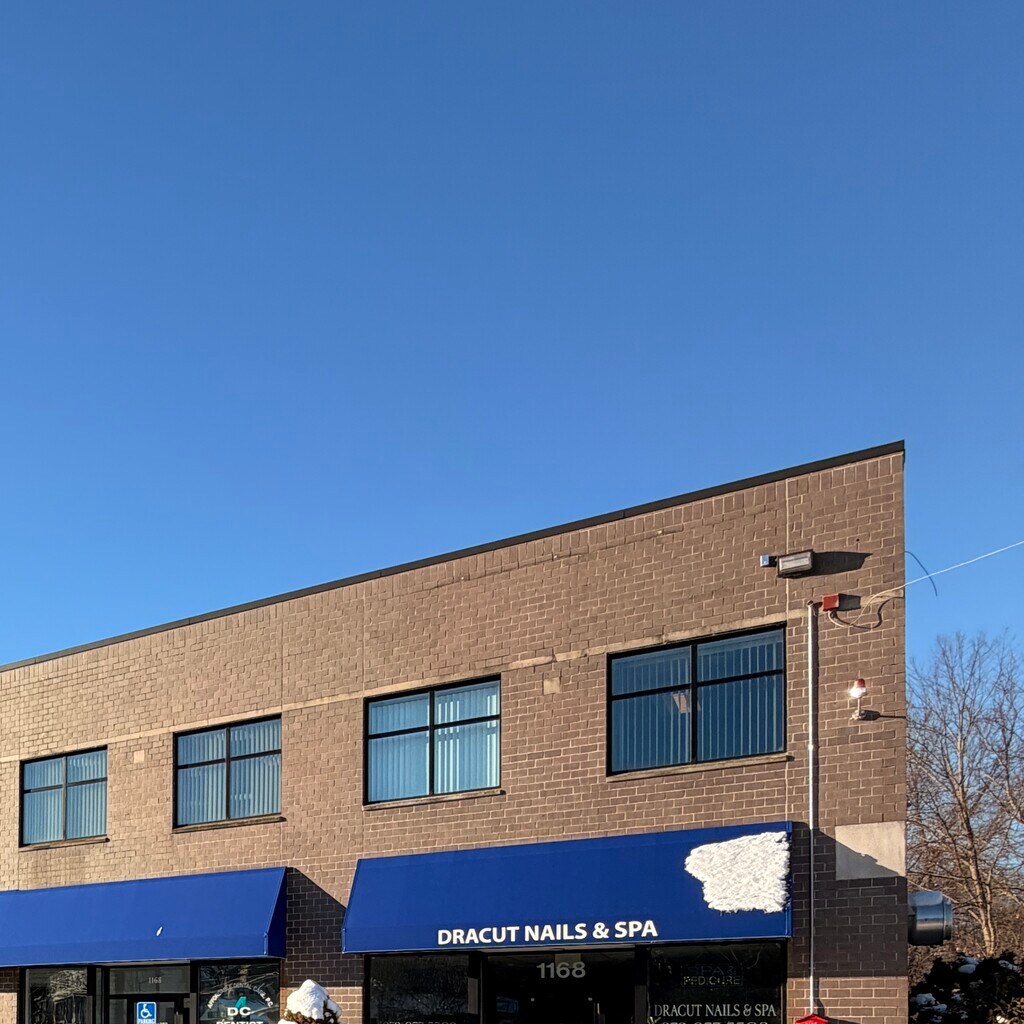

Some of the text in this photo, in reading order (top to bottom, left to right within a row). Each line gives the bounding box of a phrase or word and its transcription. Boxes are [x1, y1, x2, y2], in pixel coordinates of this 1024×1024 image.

[437, 920, 658, 946] DRACUT NAILS & SPA
[537, 961, 586, 979] 1168
[687, 965, 725, 976] SPA
[148, 976, 162, 984] 1168
[683, 975, 741, 986] PEDICURE
[654, 1003, 777, 1017] DRACUT NAILS & SPA
